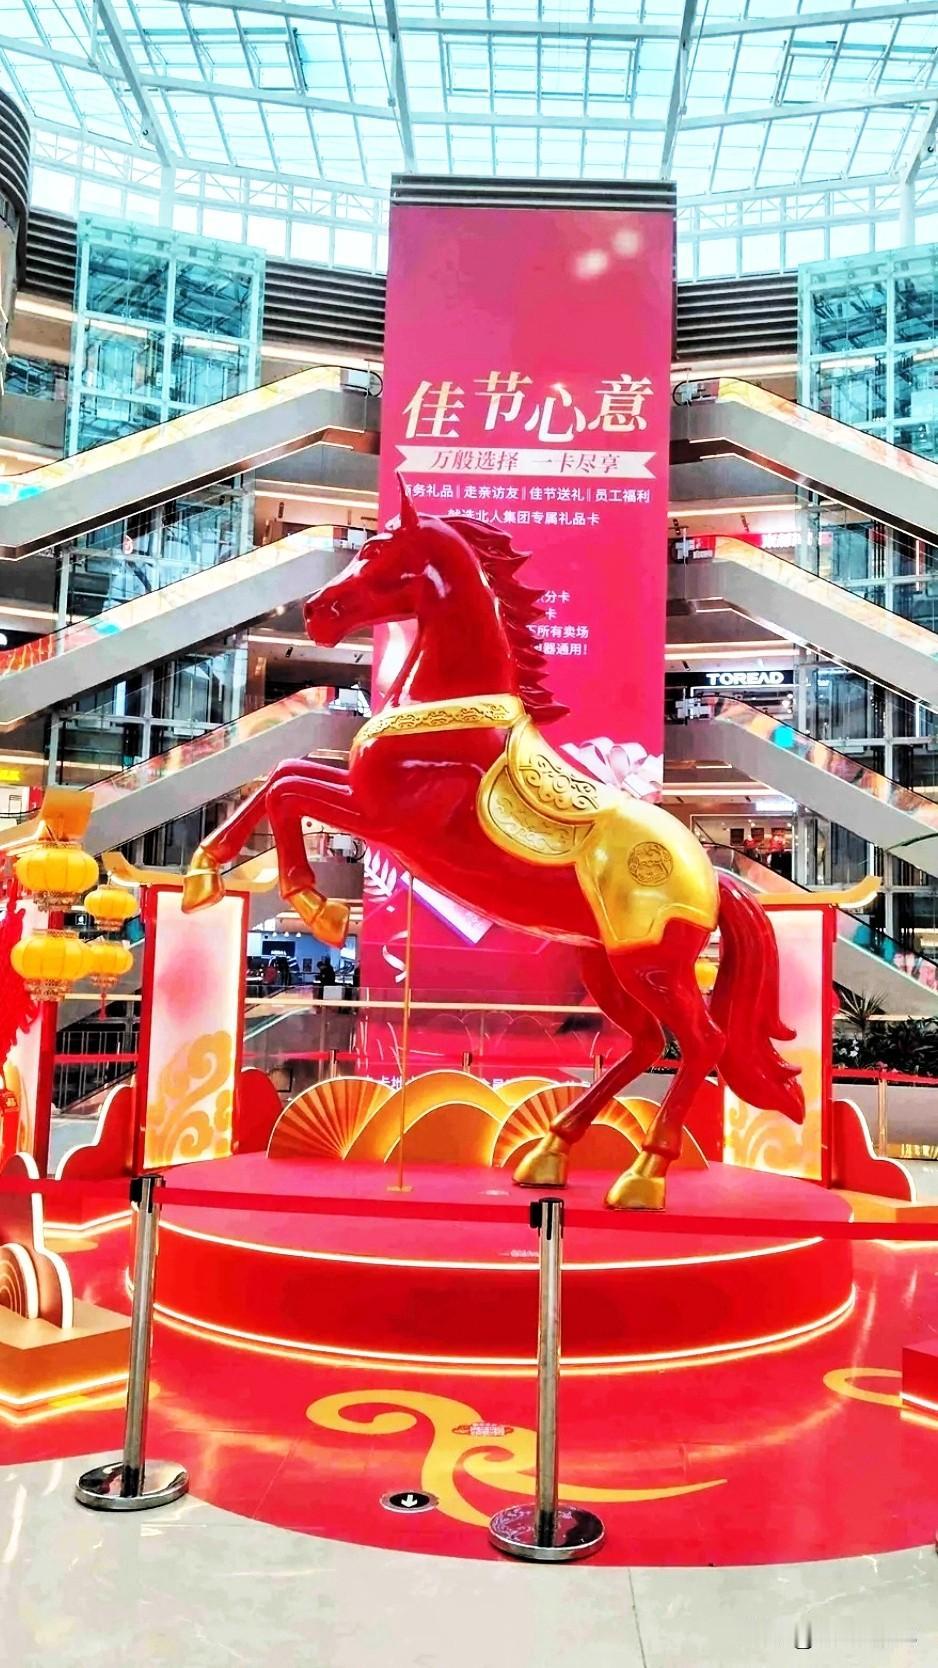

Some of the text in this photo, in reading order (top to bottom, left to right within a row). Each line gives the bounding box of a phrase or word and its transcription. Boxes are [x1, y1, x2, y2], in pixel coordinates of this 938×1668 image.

[402, 370, 654, 443] 佳节心意
[430, 449, 620, 474] 万般选择 一卡尽享
[463, 485, 519, 499] 走亲访友
[529, 487, 585, 501] 佳节送礼
[595, 488, 650, 503] 员工福利
[538, 590, 571, 604] 分卡
[705, 671, 785, 686] TOREAD
